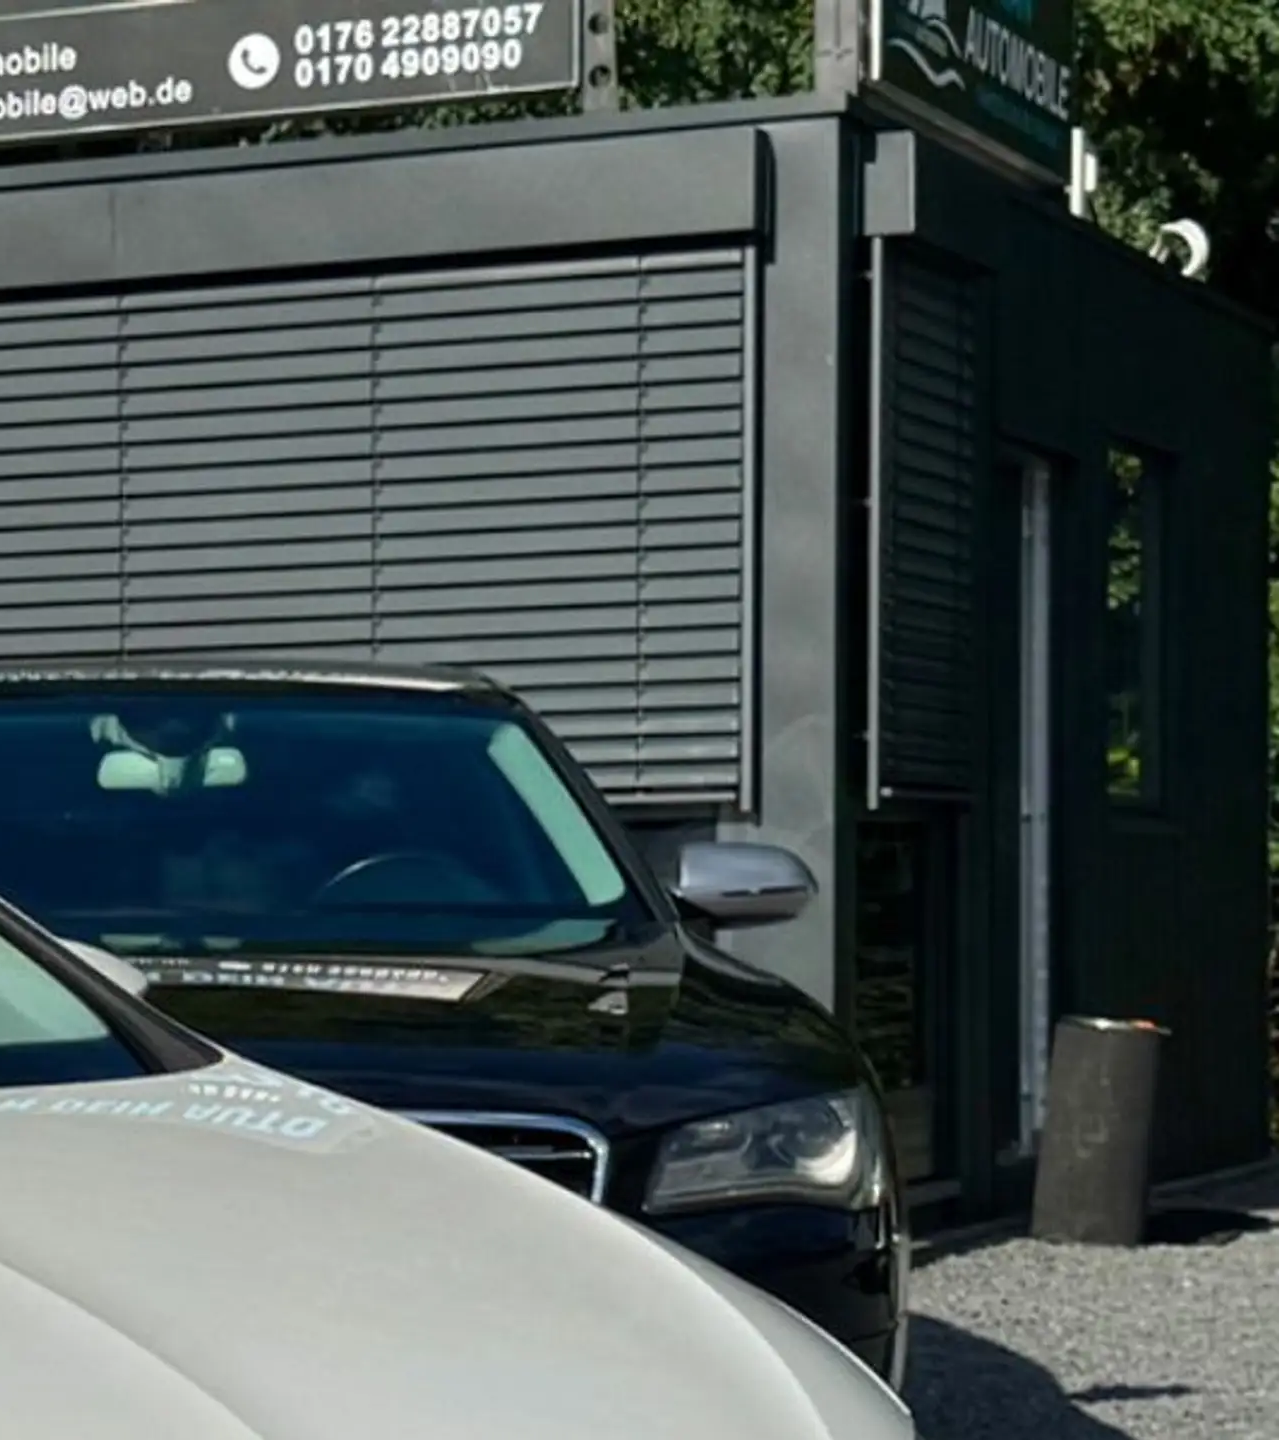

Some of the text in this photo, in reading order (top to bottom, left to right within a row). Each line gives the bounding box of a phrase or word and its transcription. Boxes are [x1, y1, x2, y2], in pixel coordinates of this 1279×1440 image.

[294, 2, 543, 55] 0176 22887057
[294, 37, 522, 88] 0170 4909090
